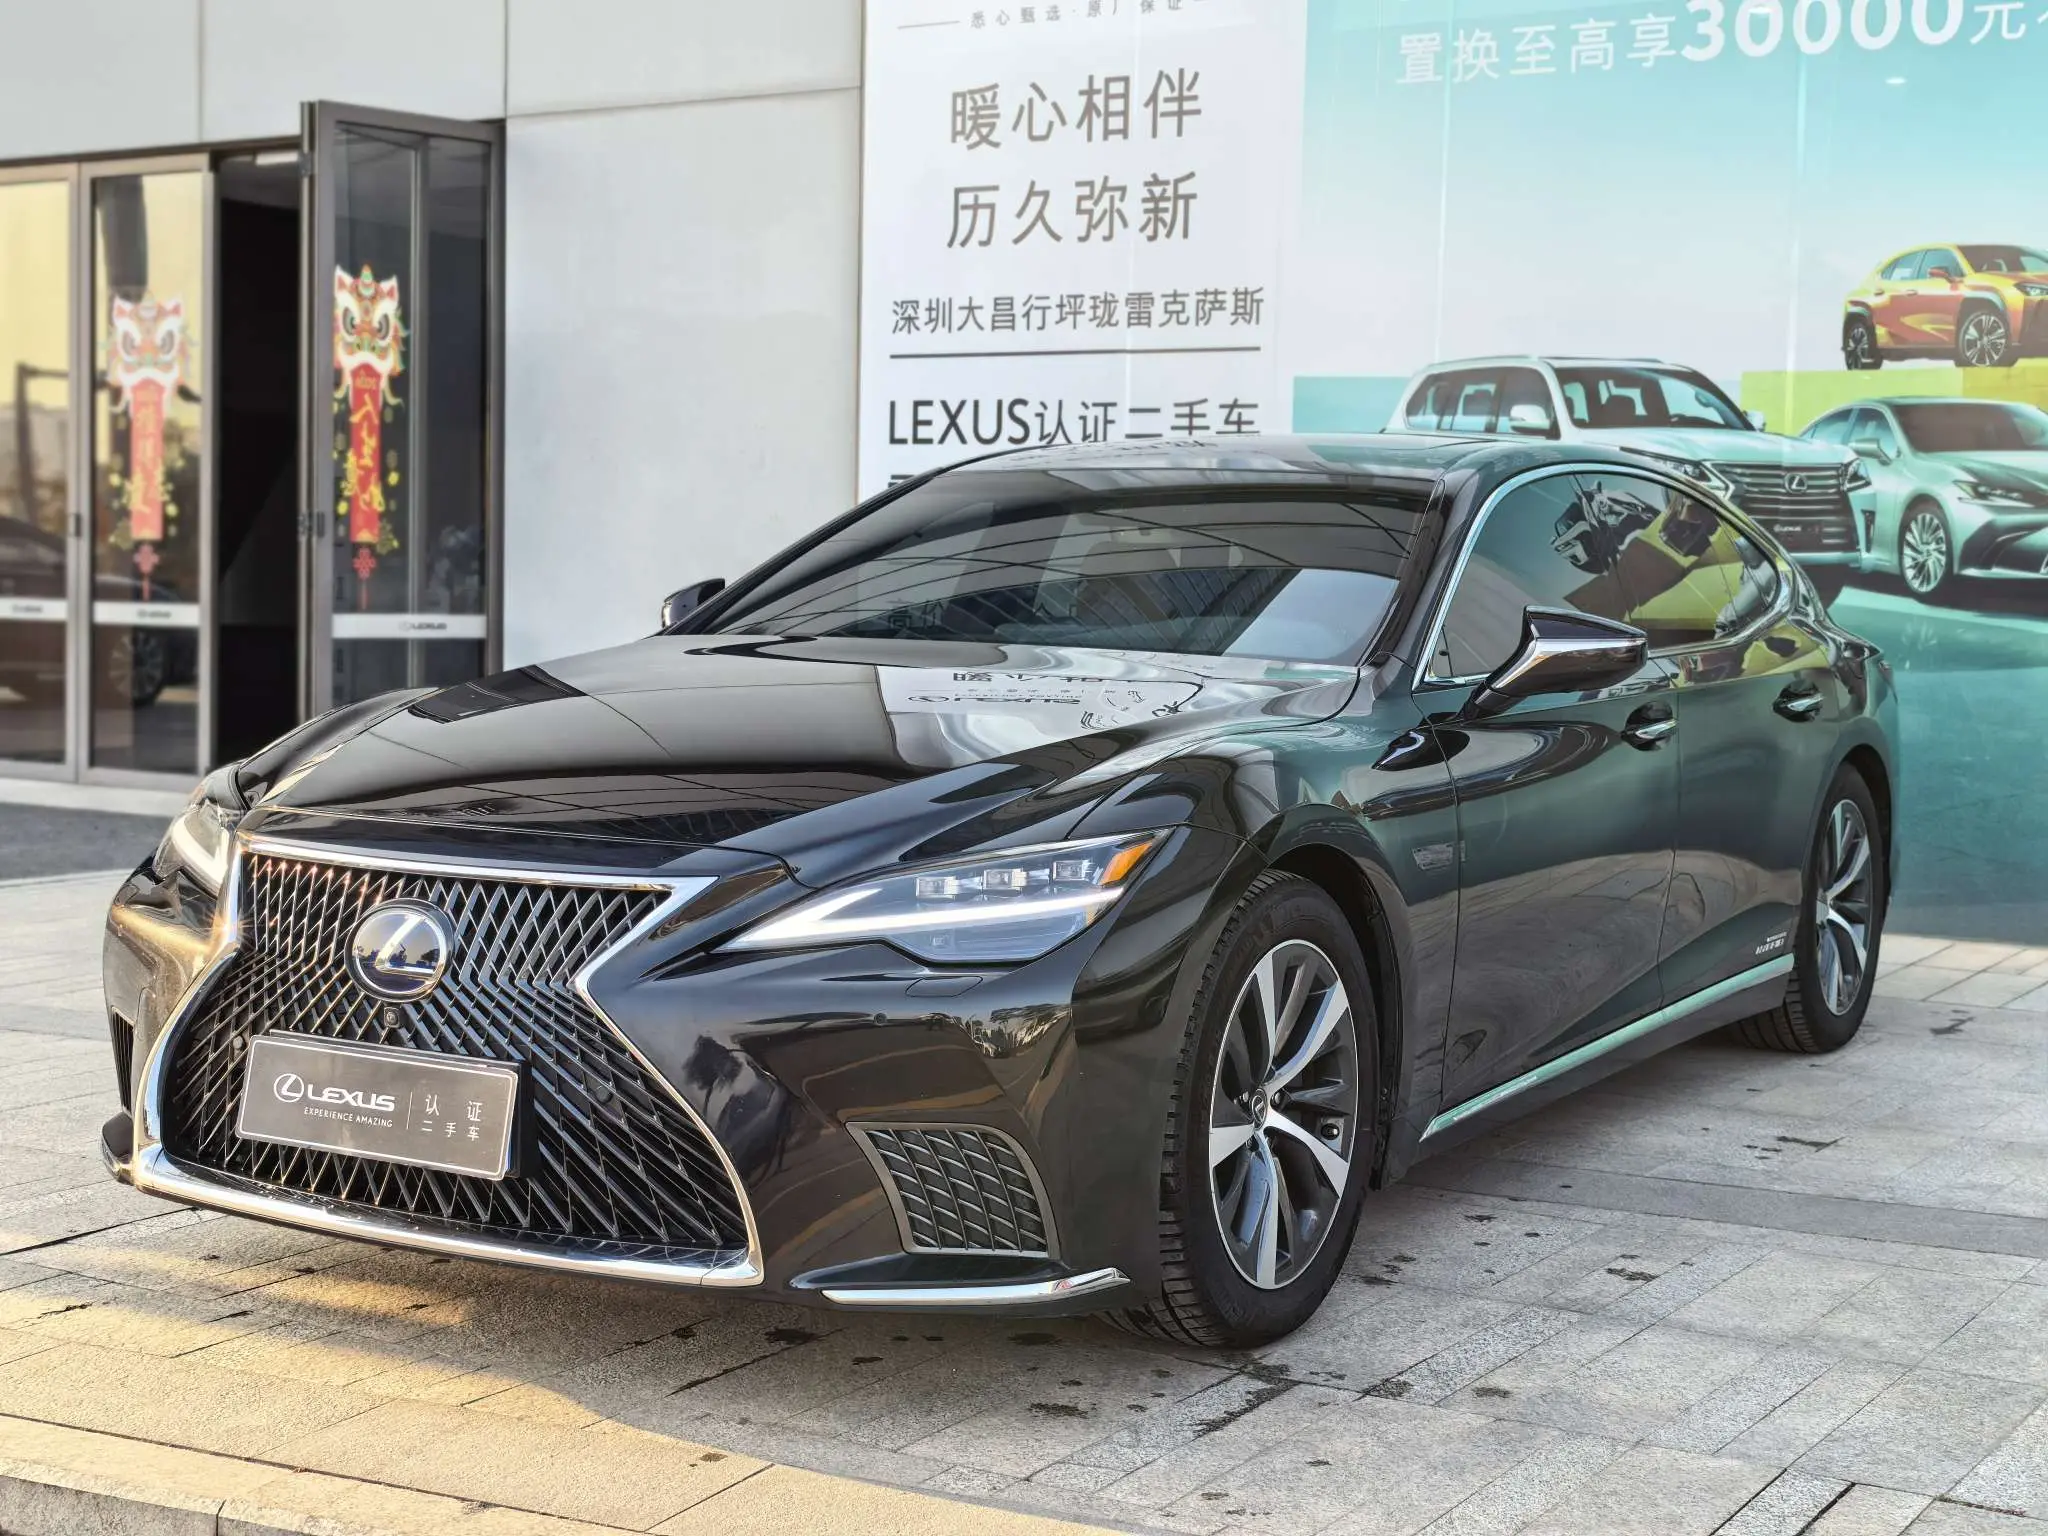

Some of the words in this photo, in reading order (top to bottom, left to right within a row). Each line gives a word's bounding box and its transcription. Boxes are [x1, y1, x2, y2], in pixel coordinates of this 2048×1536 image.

[951, 68, 1202, 151] 暖心相伴
[947, 171, 1198, 248] 历久弥新
[891, 287, 1265, 335] 深圳大昌行坪珑雷克萨斯
[303, 1106, 354, 1122] EXPERIENCE
[355, 1115, 394, 1128] AMAZING
[307, 1083, 396, 1112] LEXUS
